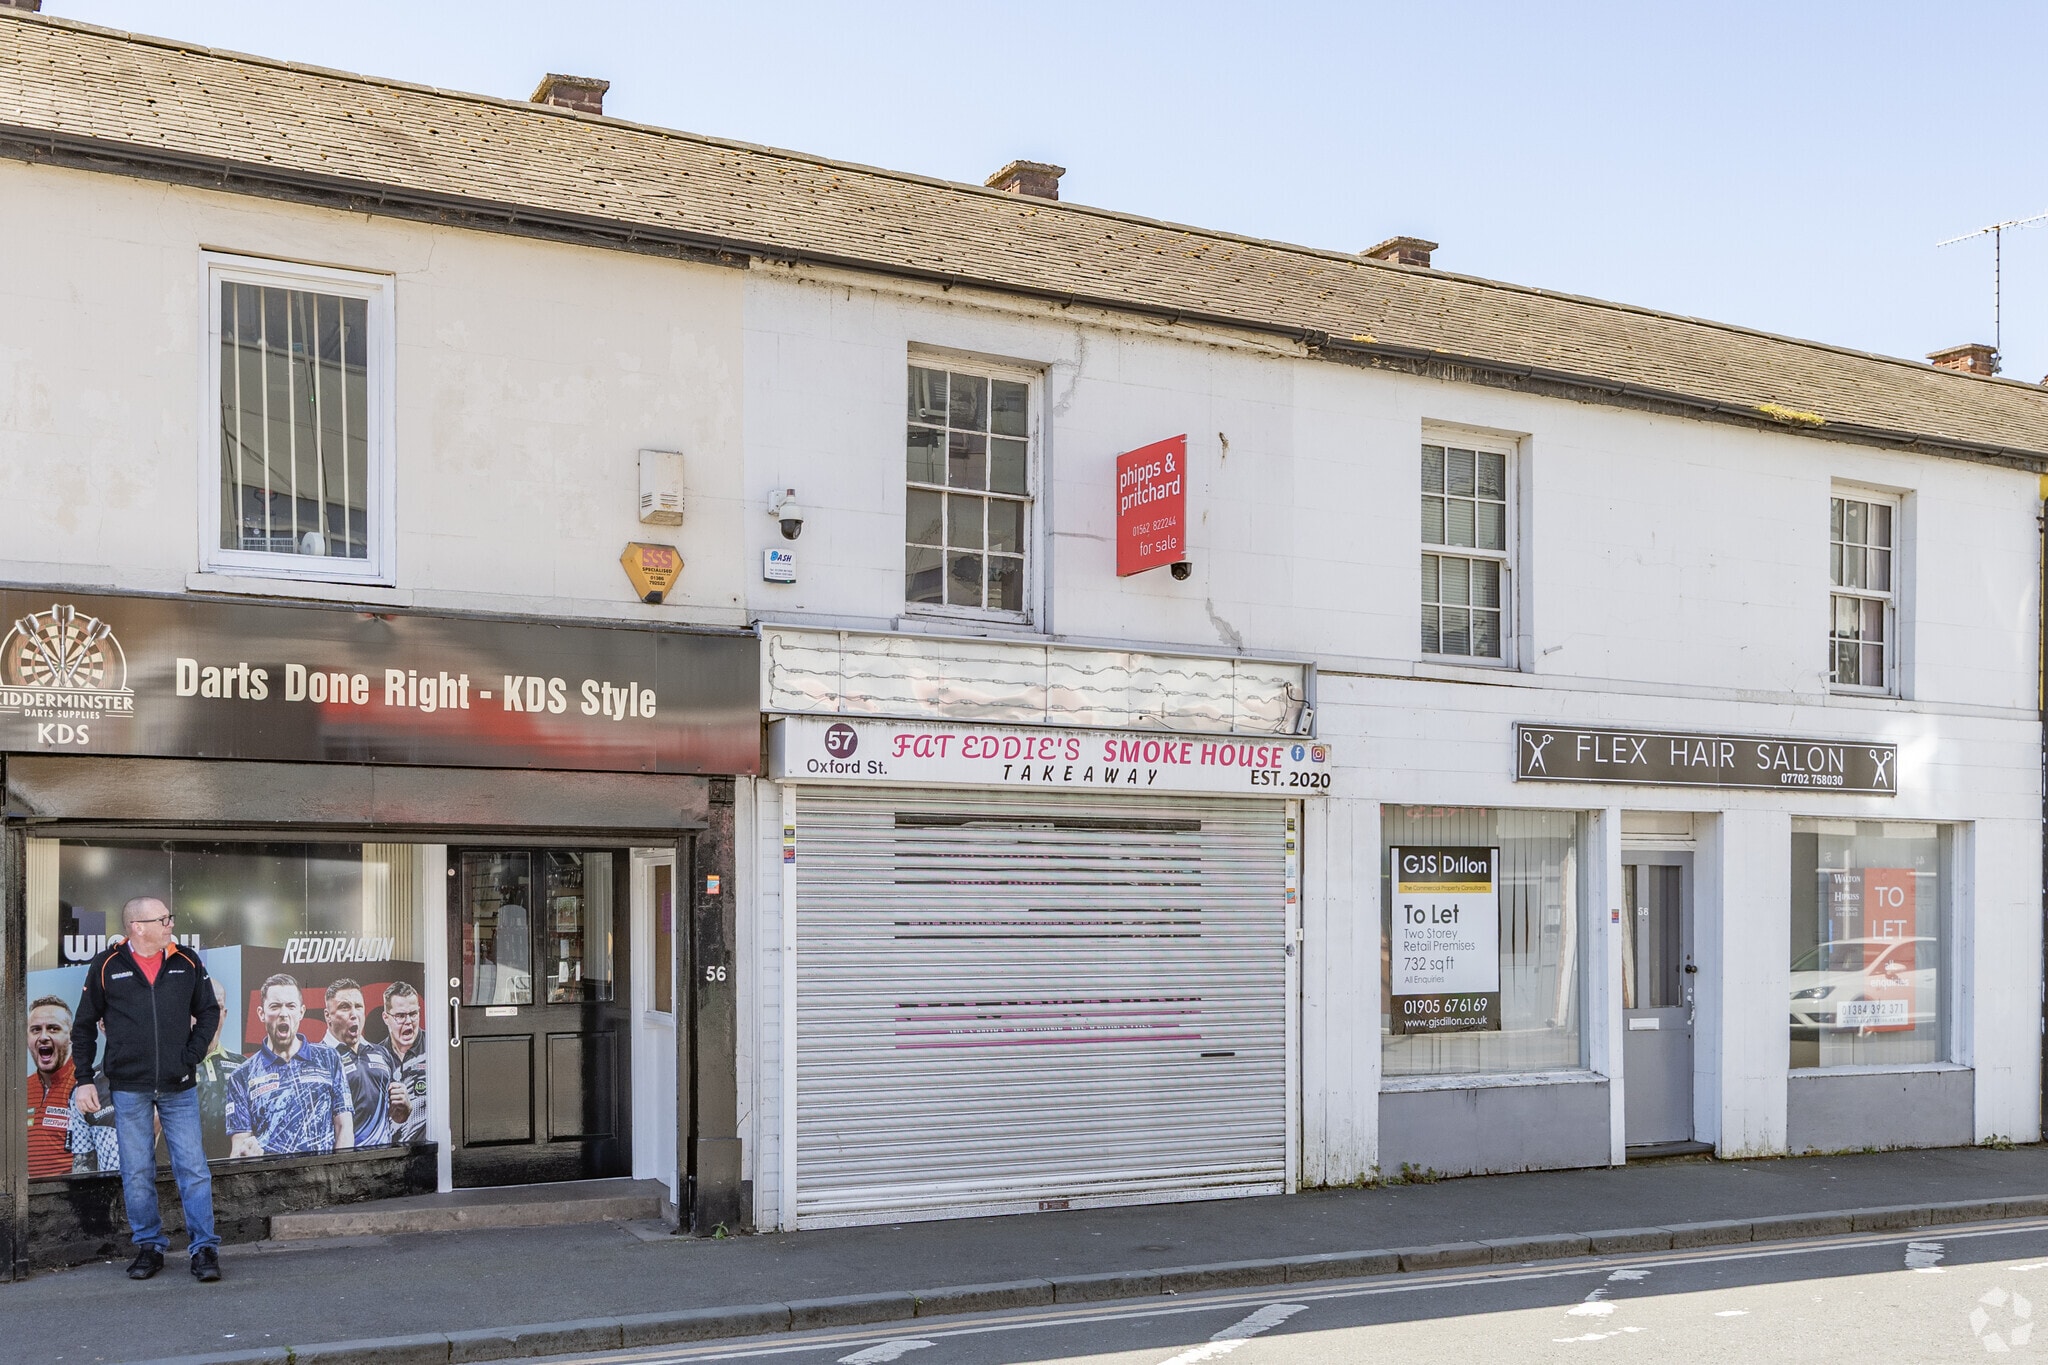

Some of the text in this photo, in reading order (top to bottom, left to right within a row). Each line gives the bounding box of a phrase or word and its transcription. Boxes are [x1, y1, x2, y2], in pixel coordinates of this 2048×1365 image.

[1120, 452, 1176, 494] phipps &
[1121, 473, 1181, 516] pritchard
[1132, 515, 1177, 537] 01562 822244
[1140, 534, 1177, 557] for sale
[175, 657, 657, 721] Darts Done Right - KDS Style
[24, 708, 101, 720] DARTS SUPPLIES
[37, 722, 90, 745] KDS
[827, 730, 855, 751] 57
[891, 733, 1284, 768] FAT EDDIE'S SMOKE HOUSE
[1576, 735, 1845, 773] FLEX HAIR SALON
[806, 758, 888, 775] Oxford St.
[1250, 769, 1331, 789] EST. 2020
[1781, 772, 1844, 786] 07702 758030
[1403, 854, 1488, 874] GJS Dillon
[1874, 886, 1905, 908] TO
[1404, 903, 1460, 924] To Let
[1637, 906, 1649, 916] 58
[1404, 927, 1458, 940] Two Storey
[1872, 919, 1907, 940] LET
[282, 936, 395, 964] REDDRAGON
[1403, 939, 1476, 952] Retail Premises
[705, 965, 727, 982] 56
[1404, 955, 1455, 973] 732 sq ft
[1404, 975, 1445, 984] All Enquiries
[1404, 997, 1488, 1015] 01905 676169
[1841, 1003, 1904, 1016] 01384 392 371
[1404, 1015, 1488, 1029] www.gjsdillon.co.uk
